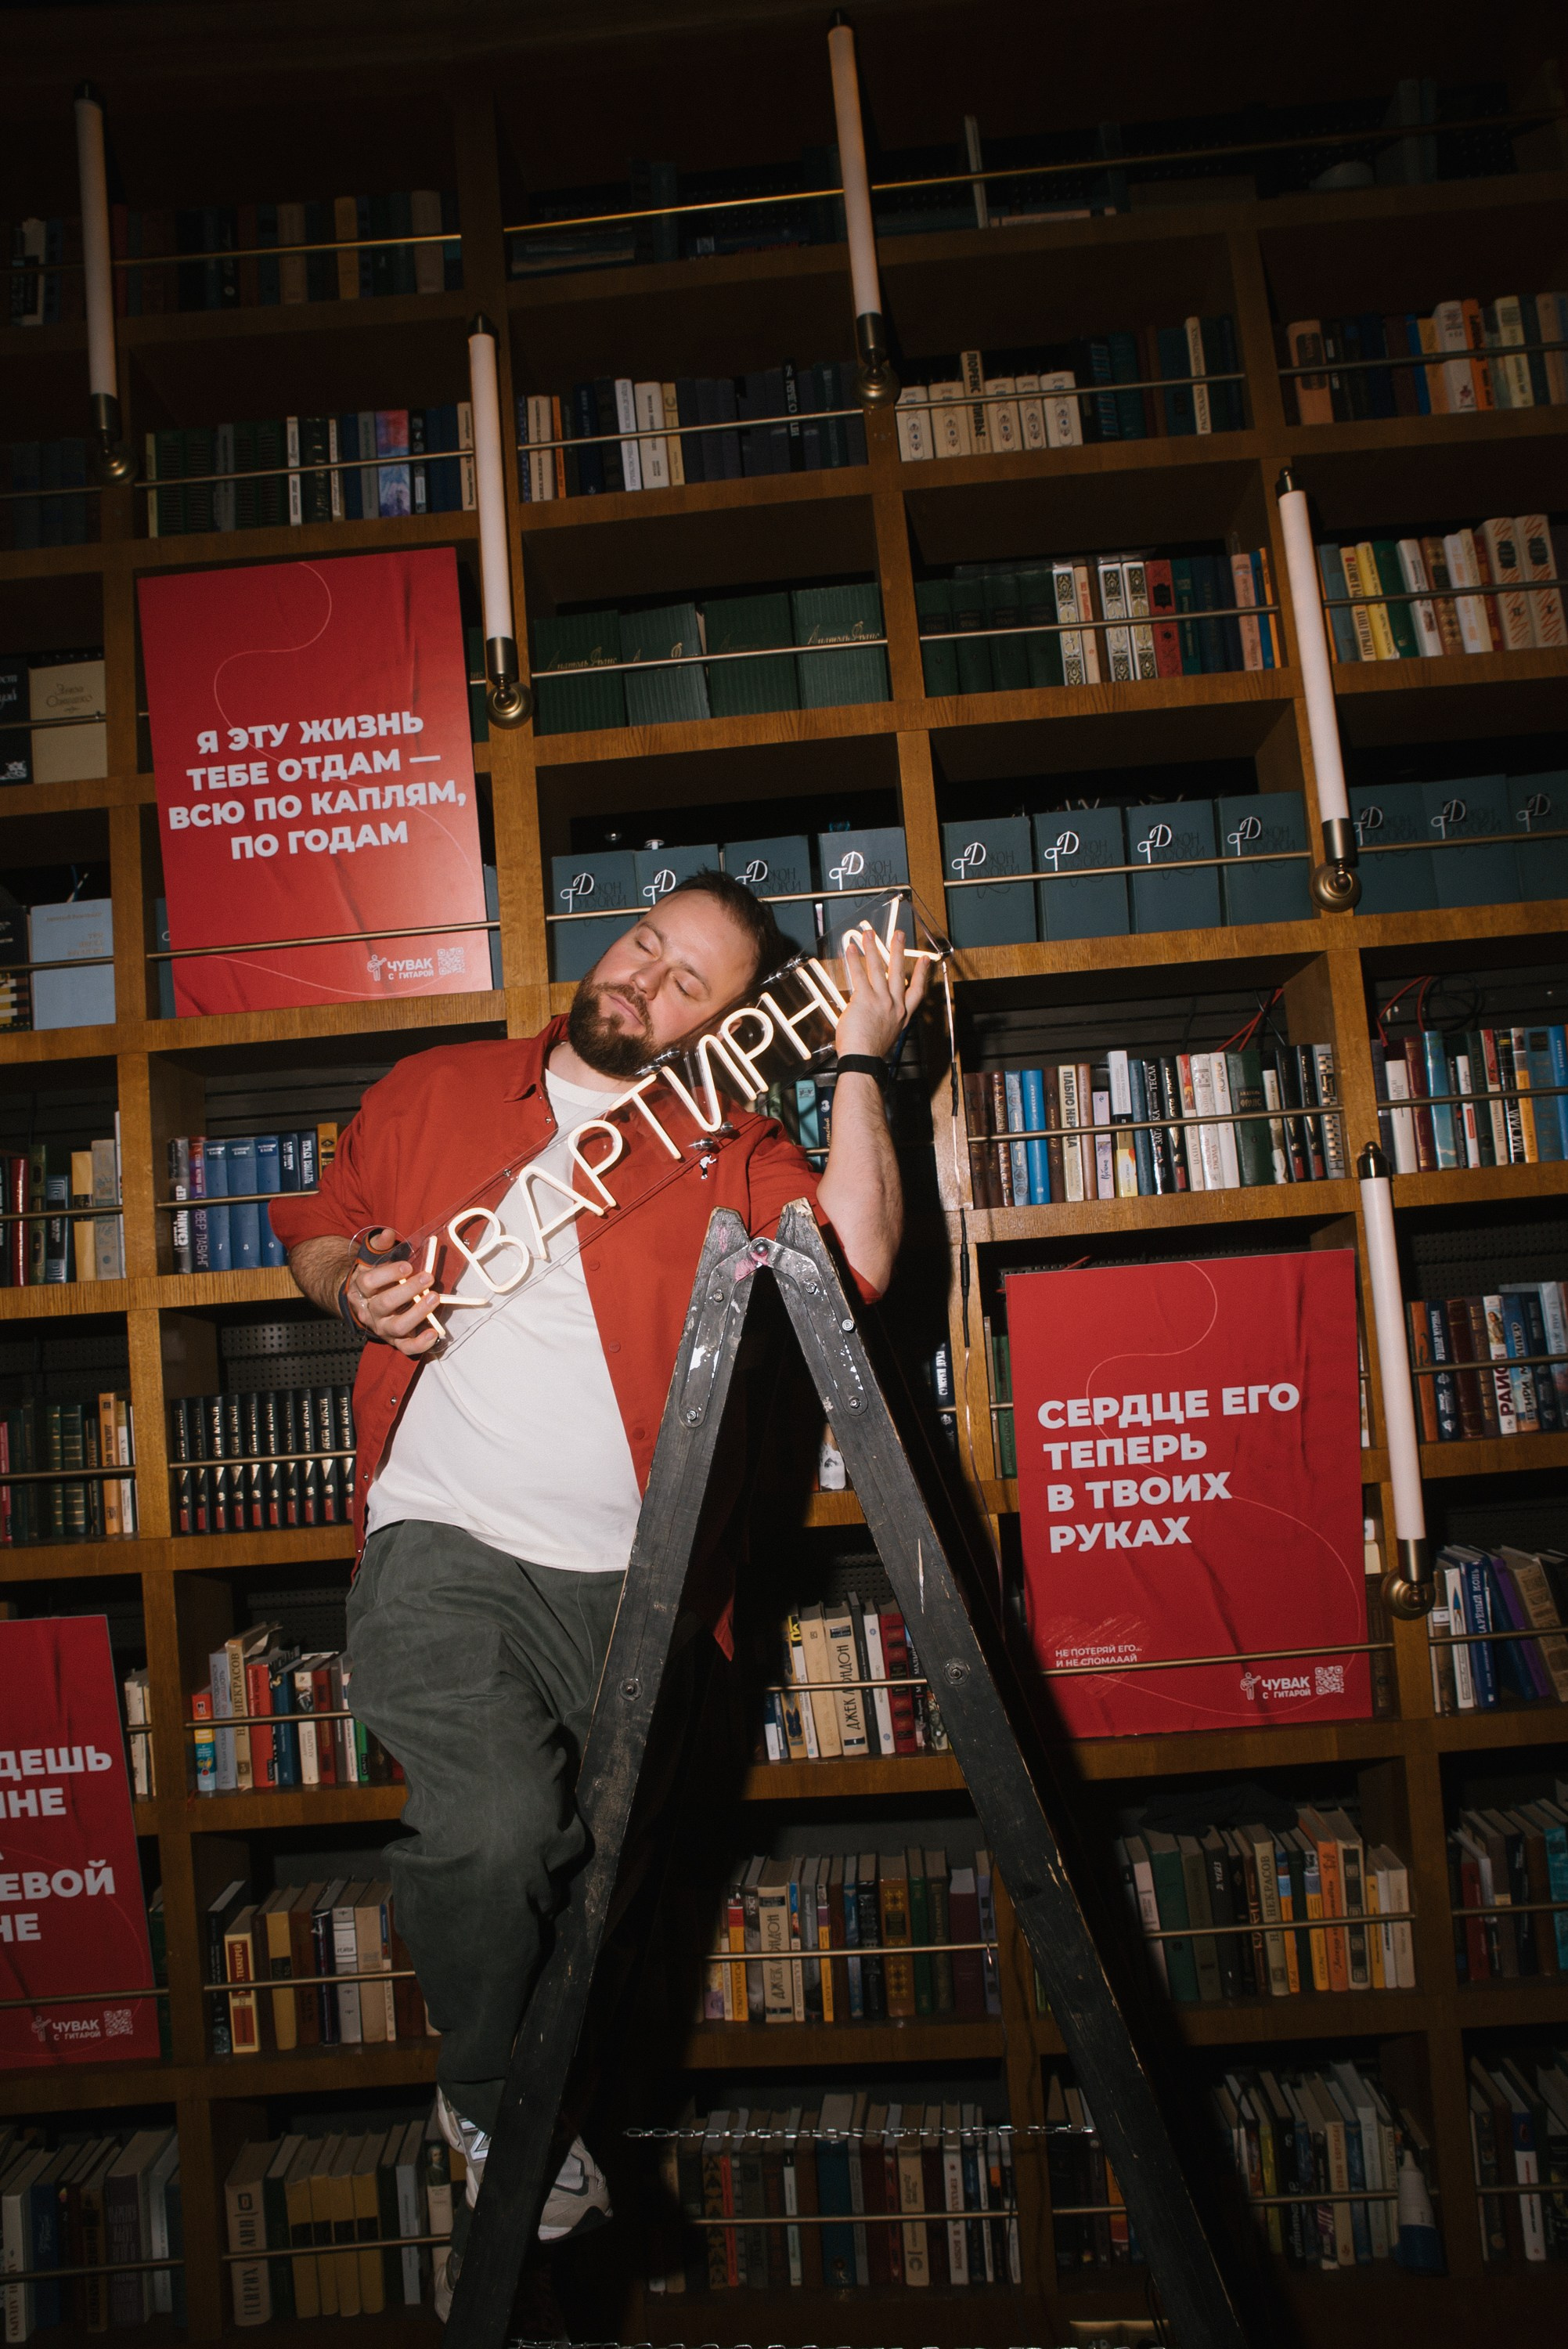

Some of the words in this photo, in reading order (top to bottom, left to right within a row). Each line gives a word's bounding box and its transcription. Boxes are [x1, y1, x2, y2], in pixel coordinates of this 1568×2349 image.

[967, 353, 982, 393] ЛОРЕНС
[973, 402, 986, 438] ЛИВЬЕ
[197, 731, 218, 754] Я
[228, 723, 289, 750] ЭТУ
[299, 711, 424, 743] ЖИЗНЬ
[186, 762, 269, 791] ТЕБЕ
[278, 749, 401, 781] ОТДАМ
[169, 801, 244, 829] ВСЮ
[254, 796, 301, 821] ПО
[312, 780, 467, 816] КАПЛЯМ,
[231, 834, 279, 859] ПО
[288, 821, 408, 854] ГОДАМ
[387, 957, 434, 972] ЧУВАК
[398, 967, 434, 980] ГИТАРОЙ
[1063, 1071, 1075, 1106] ПАБЛО
[1066, 1109, 1078, 1148] НЕРДА
[1152, 1110, 1164, 1146] ЗАГАКА
[196, 1233, 209, 1268] ЛАВИНГ
[1512, 1322, 1530, 1375] МЛЛЕР
[1037, 1391, 1209, 1430] СЕРДЦЕ
[1222, 1383, 1299, 1415] ЕГО
[1523, 1381, 1535, 1421] ГЕНРИ
[1044, 1437, 1207, 1470] ТЕПЕРЬ
[1047, 1485, 1074, 1512] В
[1085, 1472, 1232, 1508] ТВОИХ
[1050, 1517, 1191, 1553] РУКАХ
[1472, 1568, 1481, 1593] КОНЬ
[1065, 1658, 1079, 1667] НЕ
[1080, 1653, 1137, 1666] СЛОМАААЙ
[1071, 1645, 1116, 1658] ПОТЕРЯЙ
[231, 1653, 244, 1714] НЕКРАСОВ
[1261, 1676, 1311, 1691] ЧУВАК
[1274, 1688, 1310, 1698] ГИТАРОЙ
[842, 1698, 861, 1730] ДЖЕК
[0, 1746, 112, 1781] ДЕШЬ
[0, 1860, 115, 1901] ЕВОЙ
[1261, 1855, 1277, 1917] НЕКРАСОВ
[770, 1969, 786, 2000] ДЖЕК
[52, 2019, 99, 2033] ЧУВАК
[65, 2030, 100, 2039] ГИТАРОЙ
[239, 2219, 257, 2248] АНН
[242, 2267, 261, 2316] ГЕНРИХ
